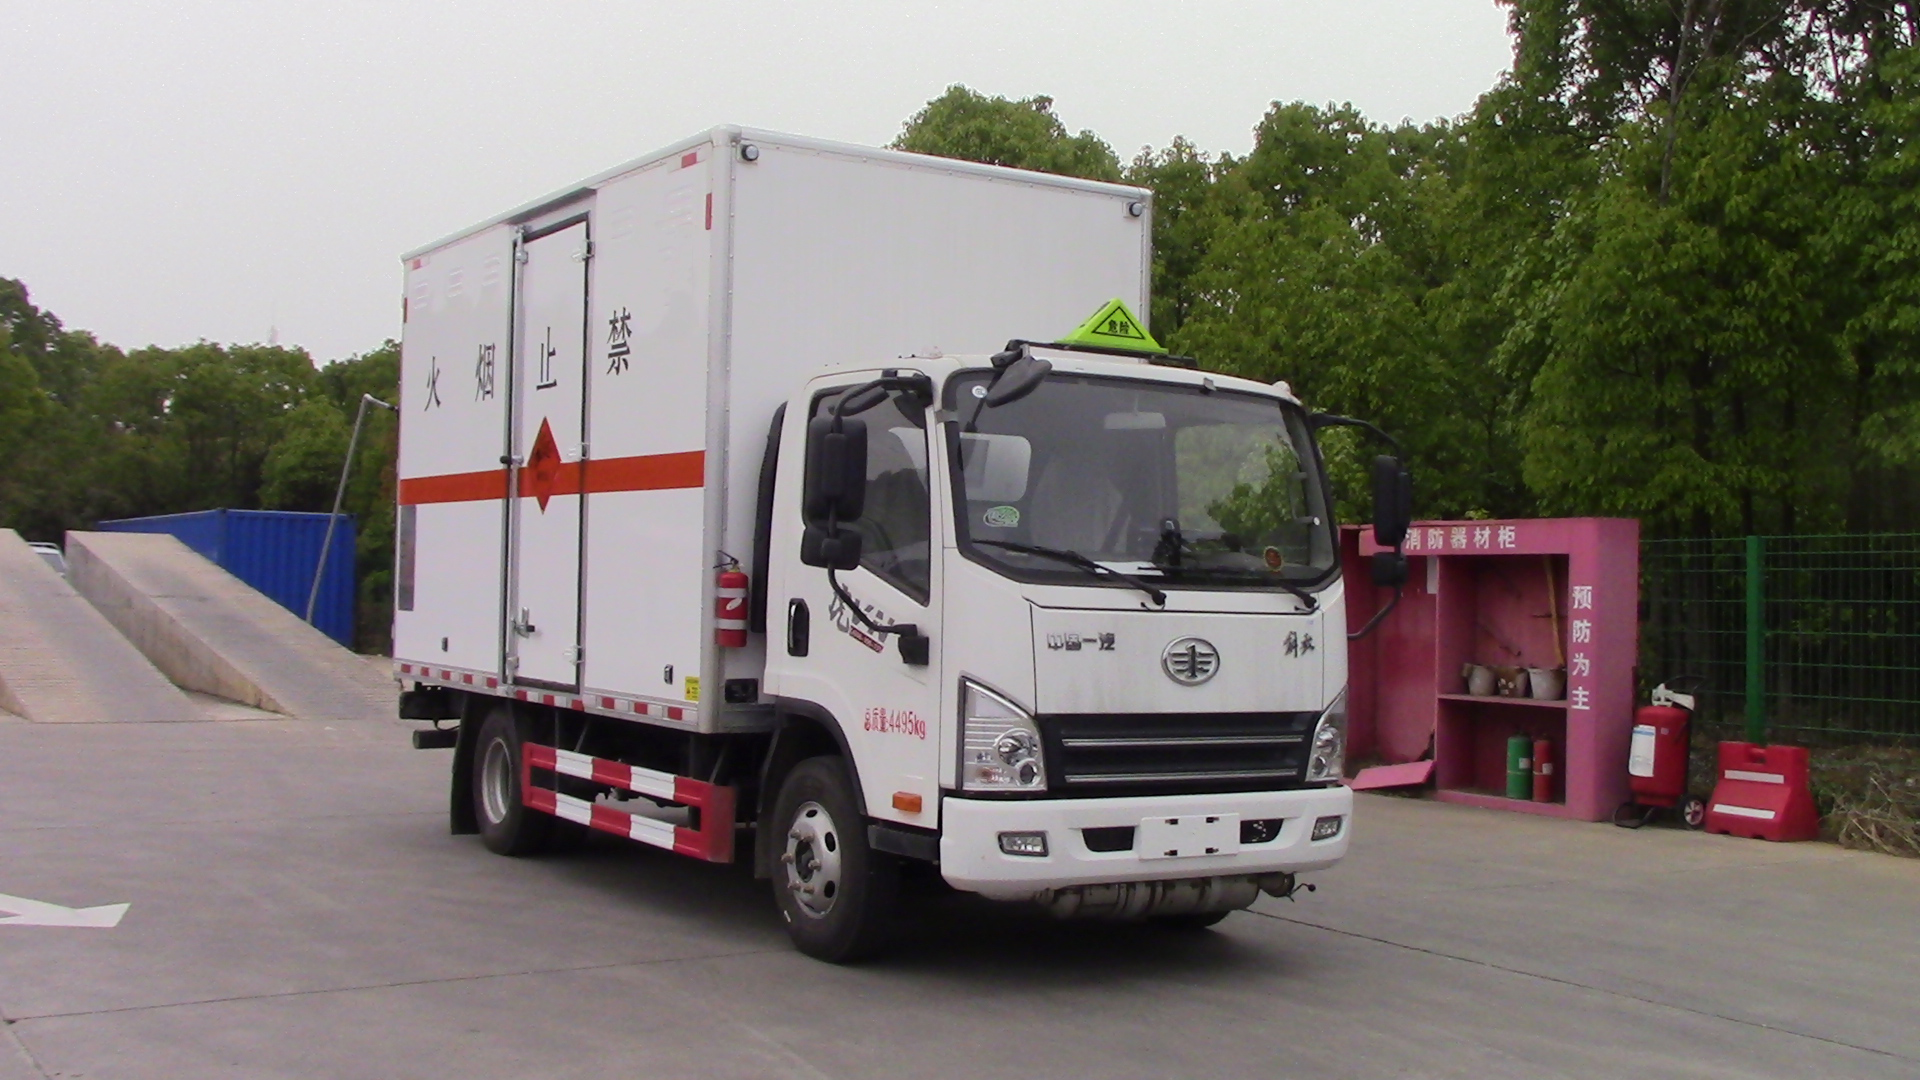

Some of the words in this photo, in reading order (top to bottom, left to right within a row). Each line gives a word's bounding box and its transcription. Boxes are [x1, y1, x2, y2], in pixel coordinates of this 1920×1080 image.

[1108, 320, 1129, 334] 危险
[1405, 525, 1516, 549] 消防器材柜
[1047, 632, 1115, 651] 中国一汽
[1572, 585, 1592, 710] 预防为主
